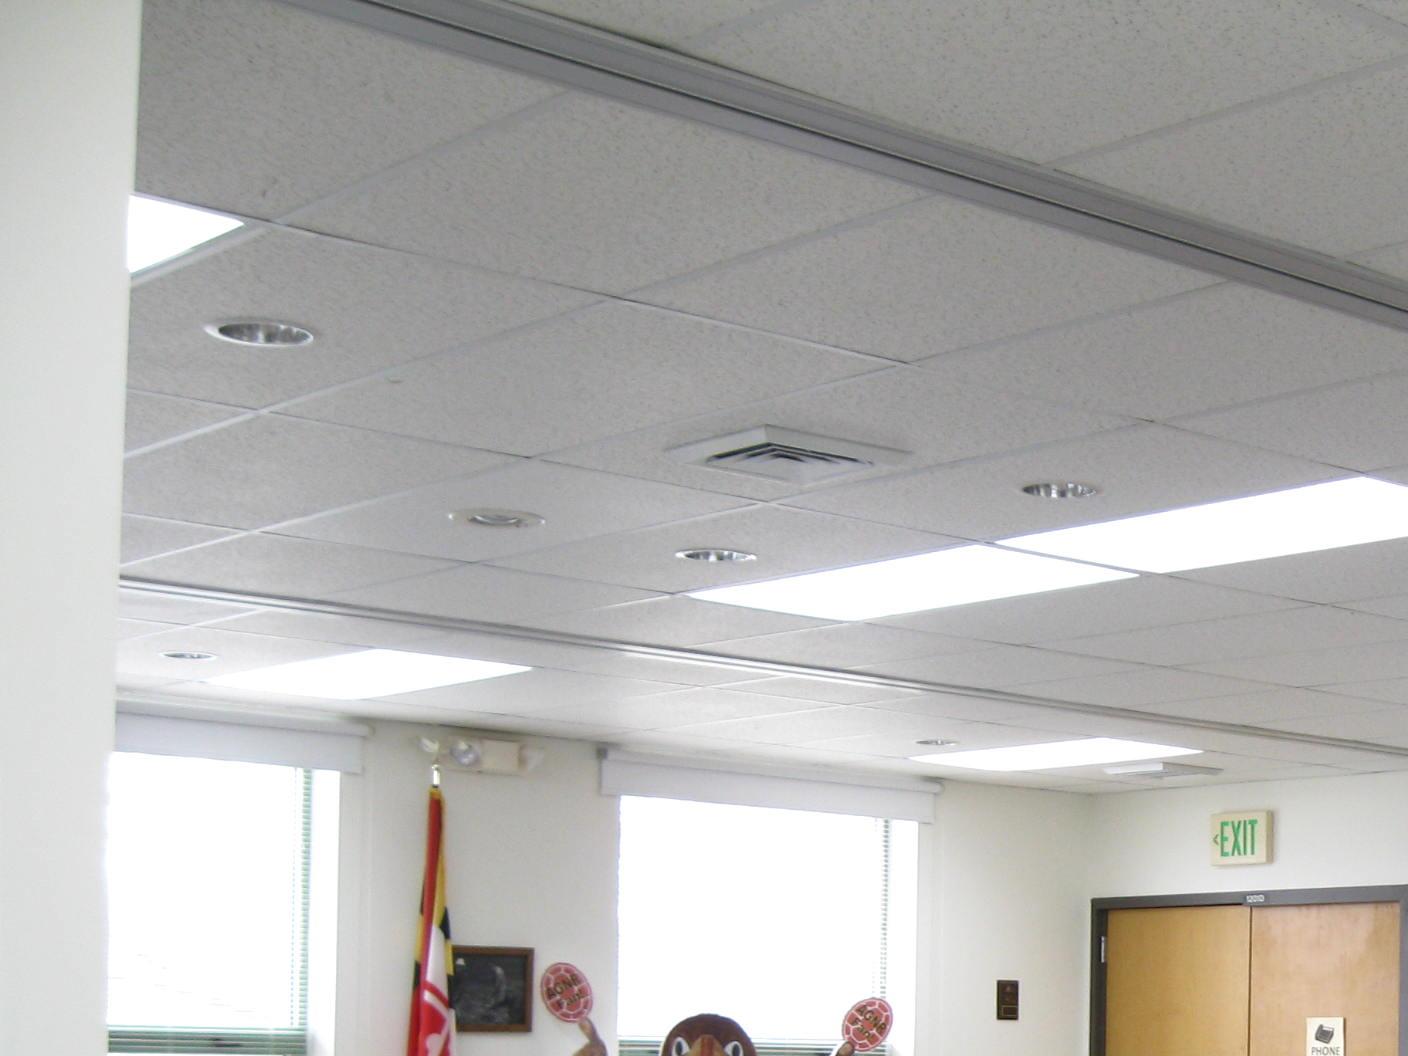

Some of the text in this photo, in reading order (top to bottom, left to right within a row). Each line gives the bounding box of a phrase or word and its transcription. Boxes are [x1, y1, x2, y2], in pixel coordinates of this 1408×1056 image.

[1220, 819, 1258, 857] EXIT
[855, 1004, 887, 1036] AGNR
[1311, 1046, 1341, 1056] PHONE
